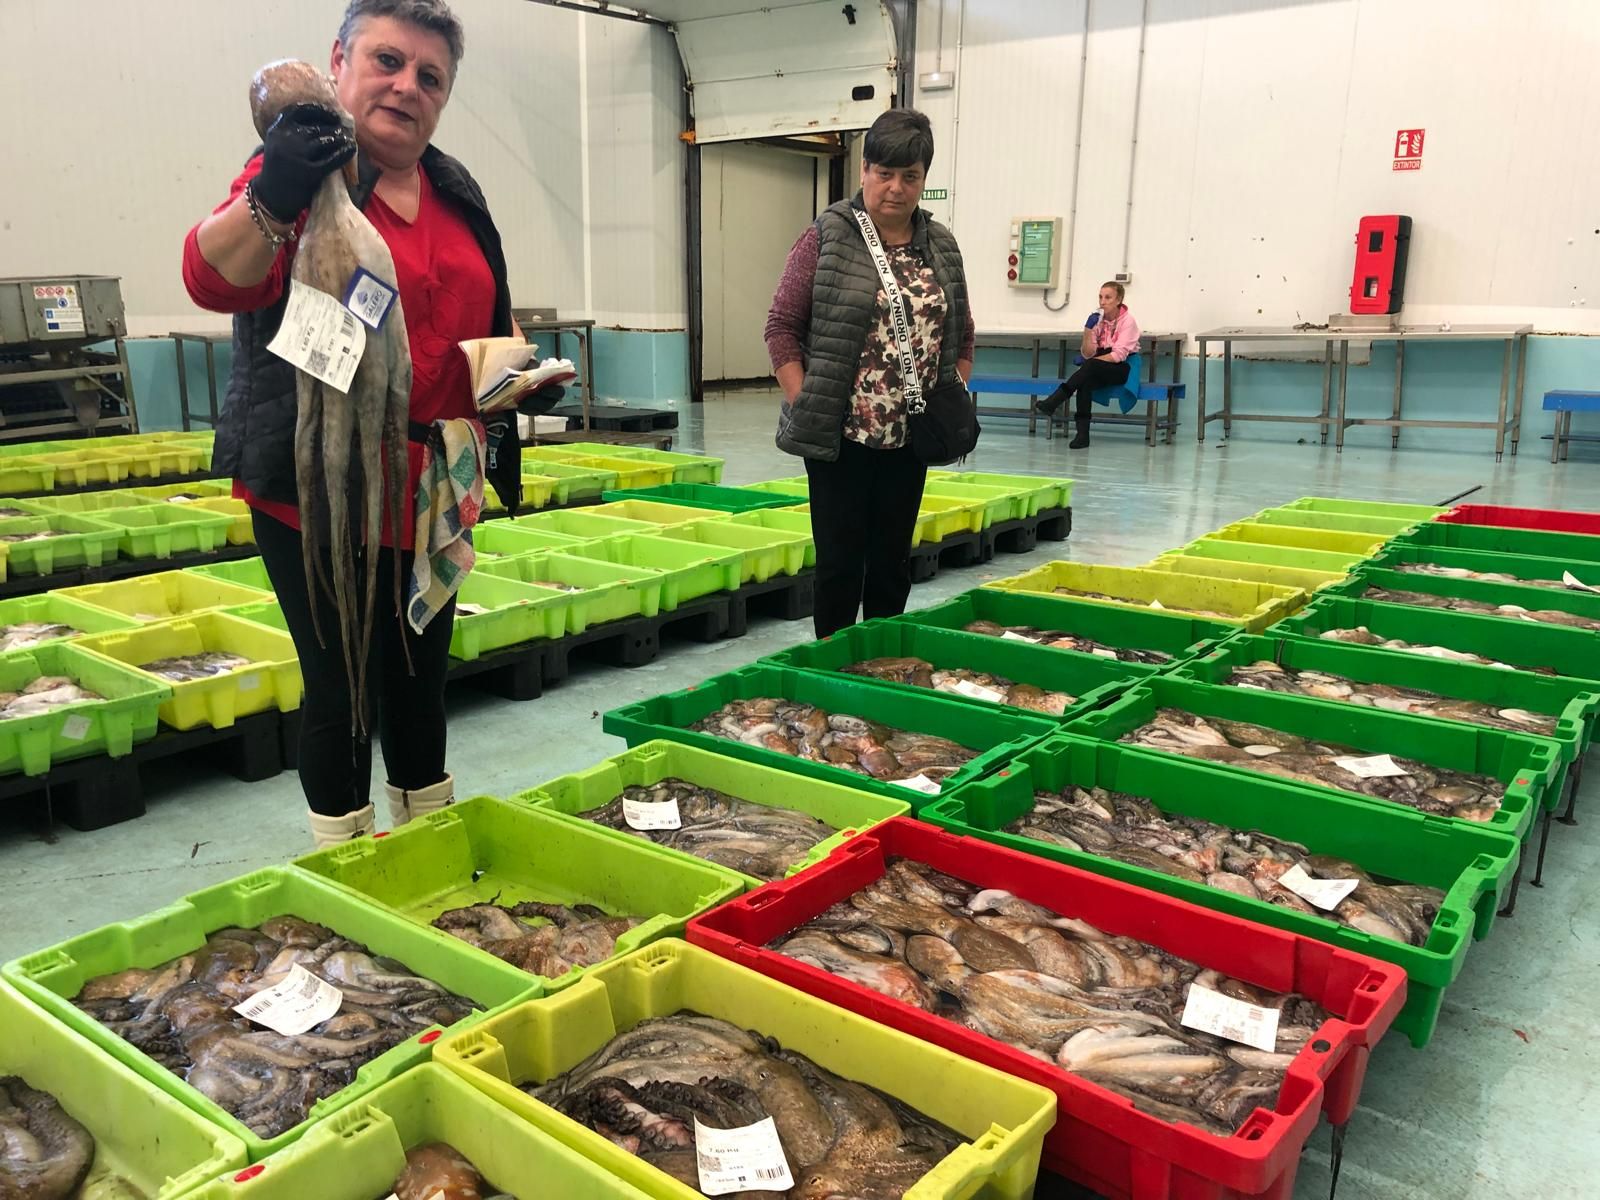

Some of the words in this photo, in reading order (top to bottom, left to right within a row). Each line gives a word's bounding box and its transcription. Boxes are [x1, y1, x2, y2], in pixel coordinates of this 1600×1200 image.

[1394, 160, 1420, 169] EXTINTOR
[922, 190, 946, 199] SALIDA
[875, 253, 890, 274] NOT
[886, 281, 907, 342] ORDINARY
[901, 350, 914, 375] NOT
